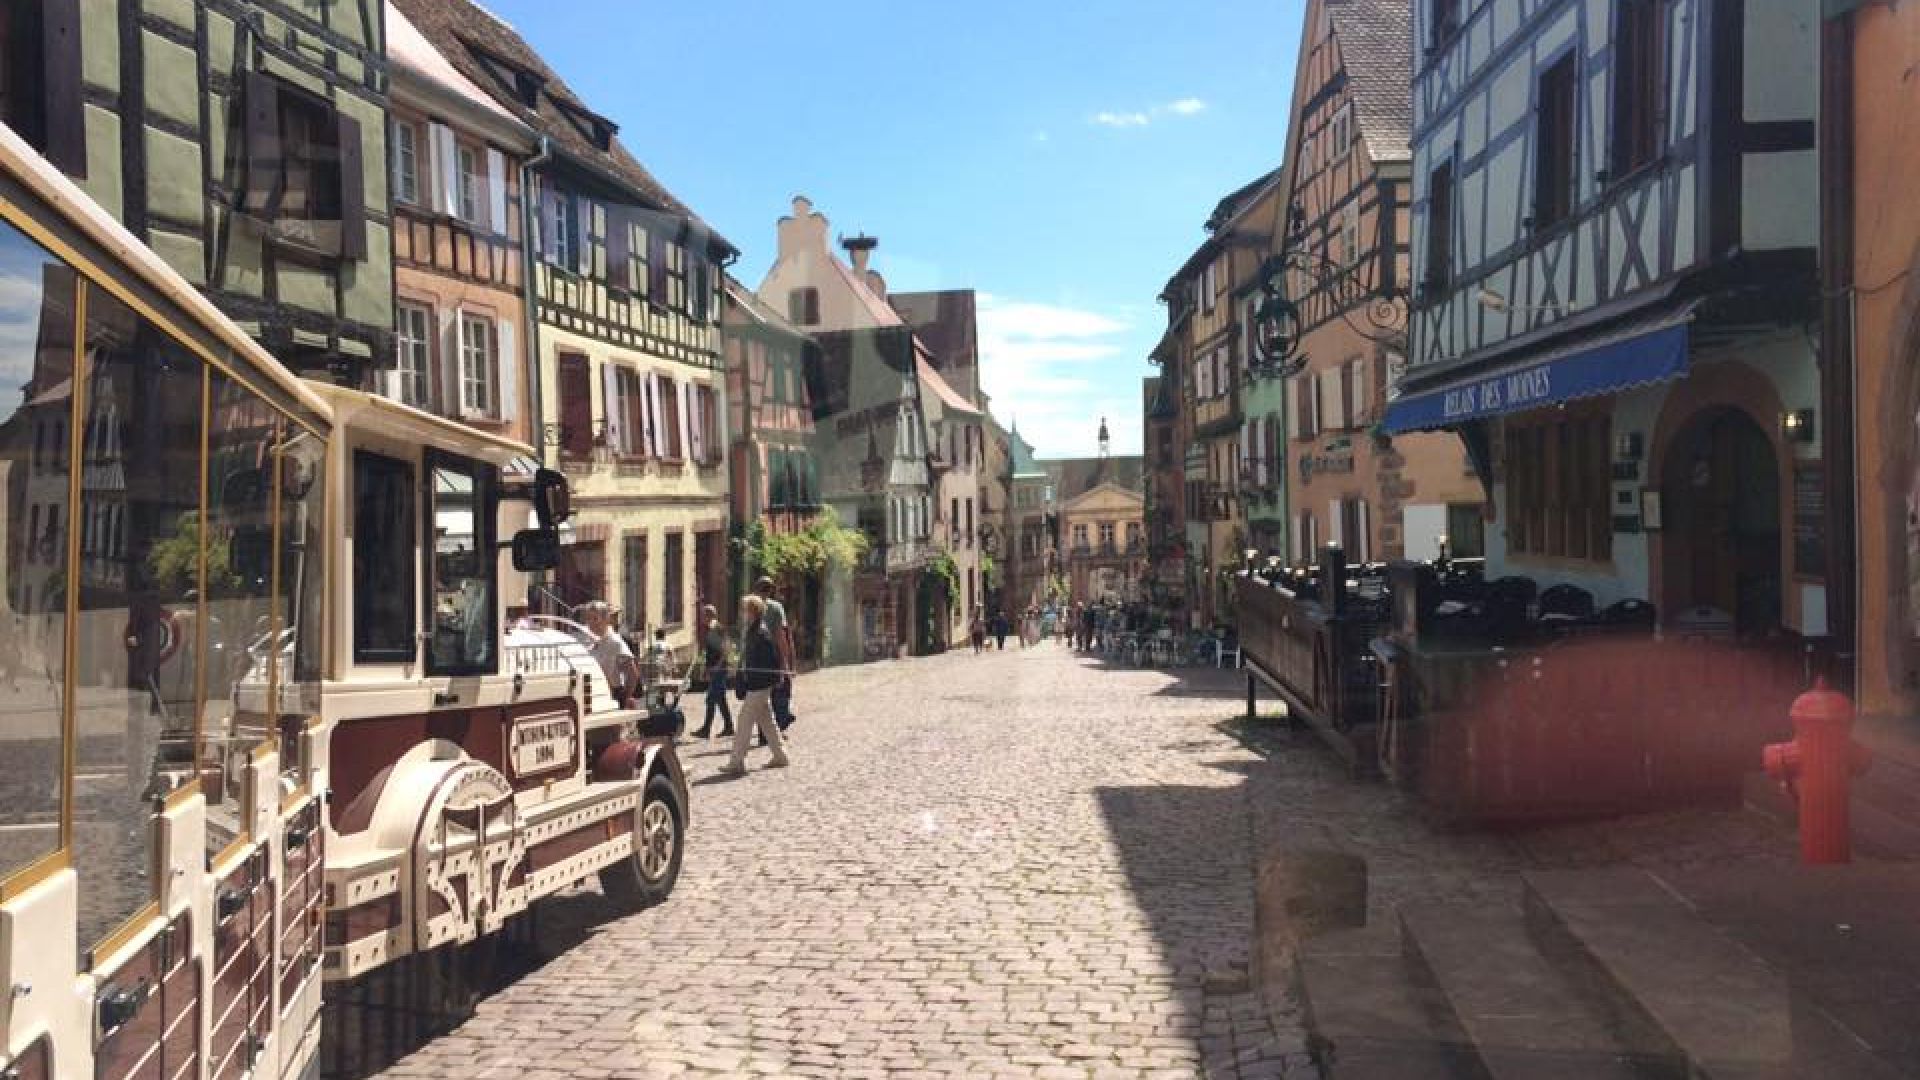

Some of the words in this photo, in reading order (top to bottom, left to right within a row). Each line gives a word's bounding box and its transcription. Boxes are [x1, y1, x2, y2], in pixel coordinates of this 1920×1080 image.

[1444, 386, 1476, 416] RELAIS
[1481, 379, 1501, 410] DES
[1507, 365, 1551, 402] MOINES
